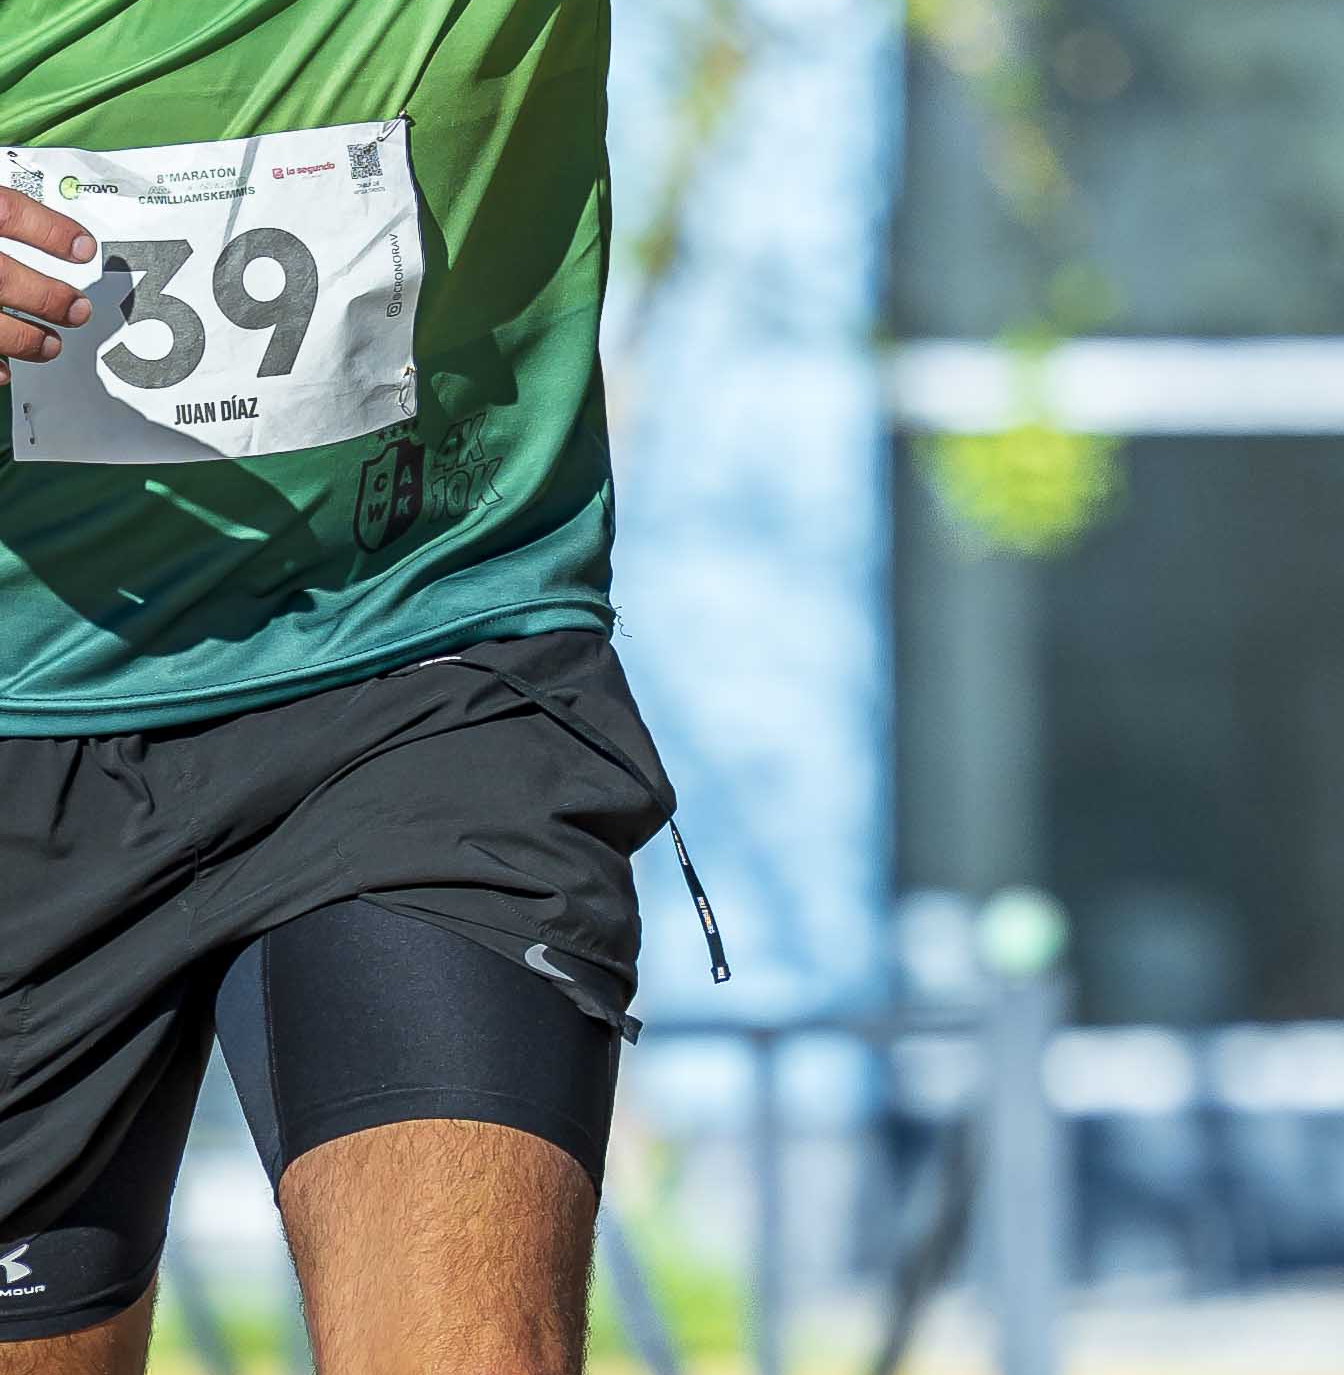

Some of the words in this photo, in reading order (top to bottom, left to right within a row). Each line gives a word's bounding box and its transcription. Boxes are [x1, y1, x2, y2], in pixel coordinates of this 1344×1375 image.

[101, 227, 318, 390] 39
[174, 401, 216, 426] JUAN
[220, 394, 260, 422] DÍAZ
